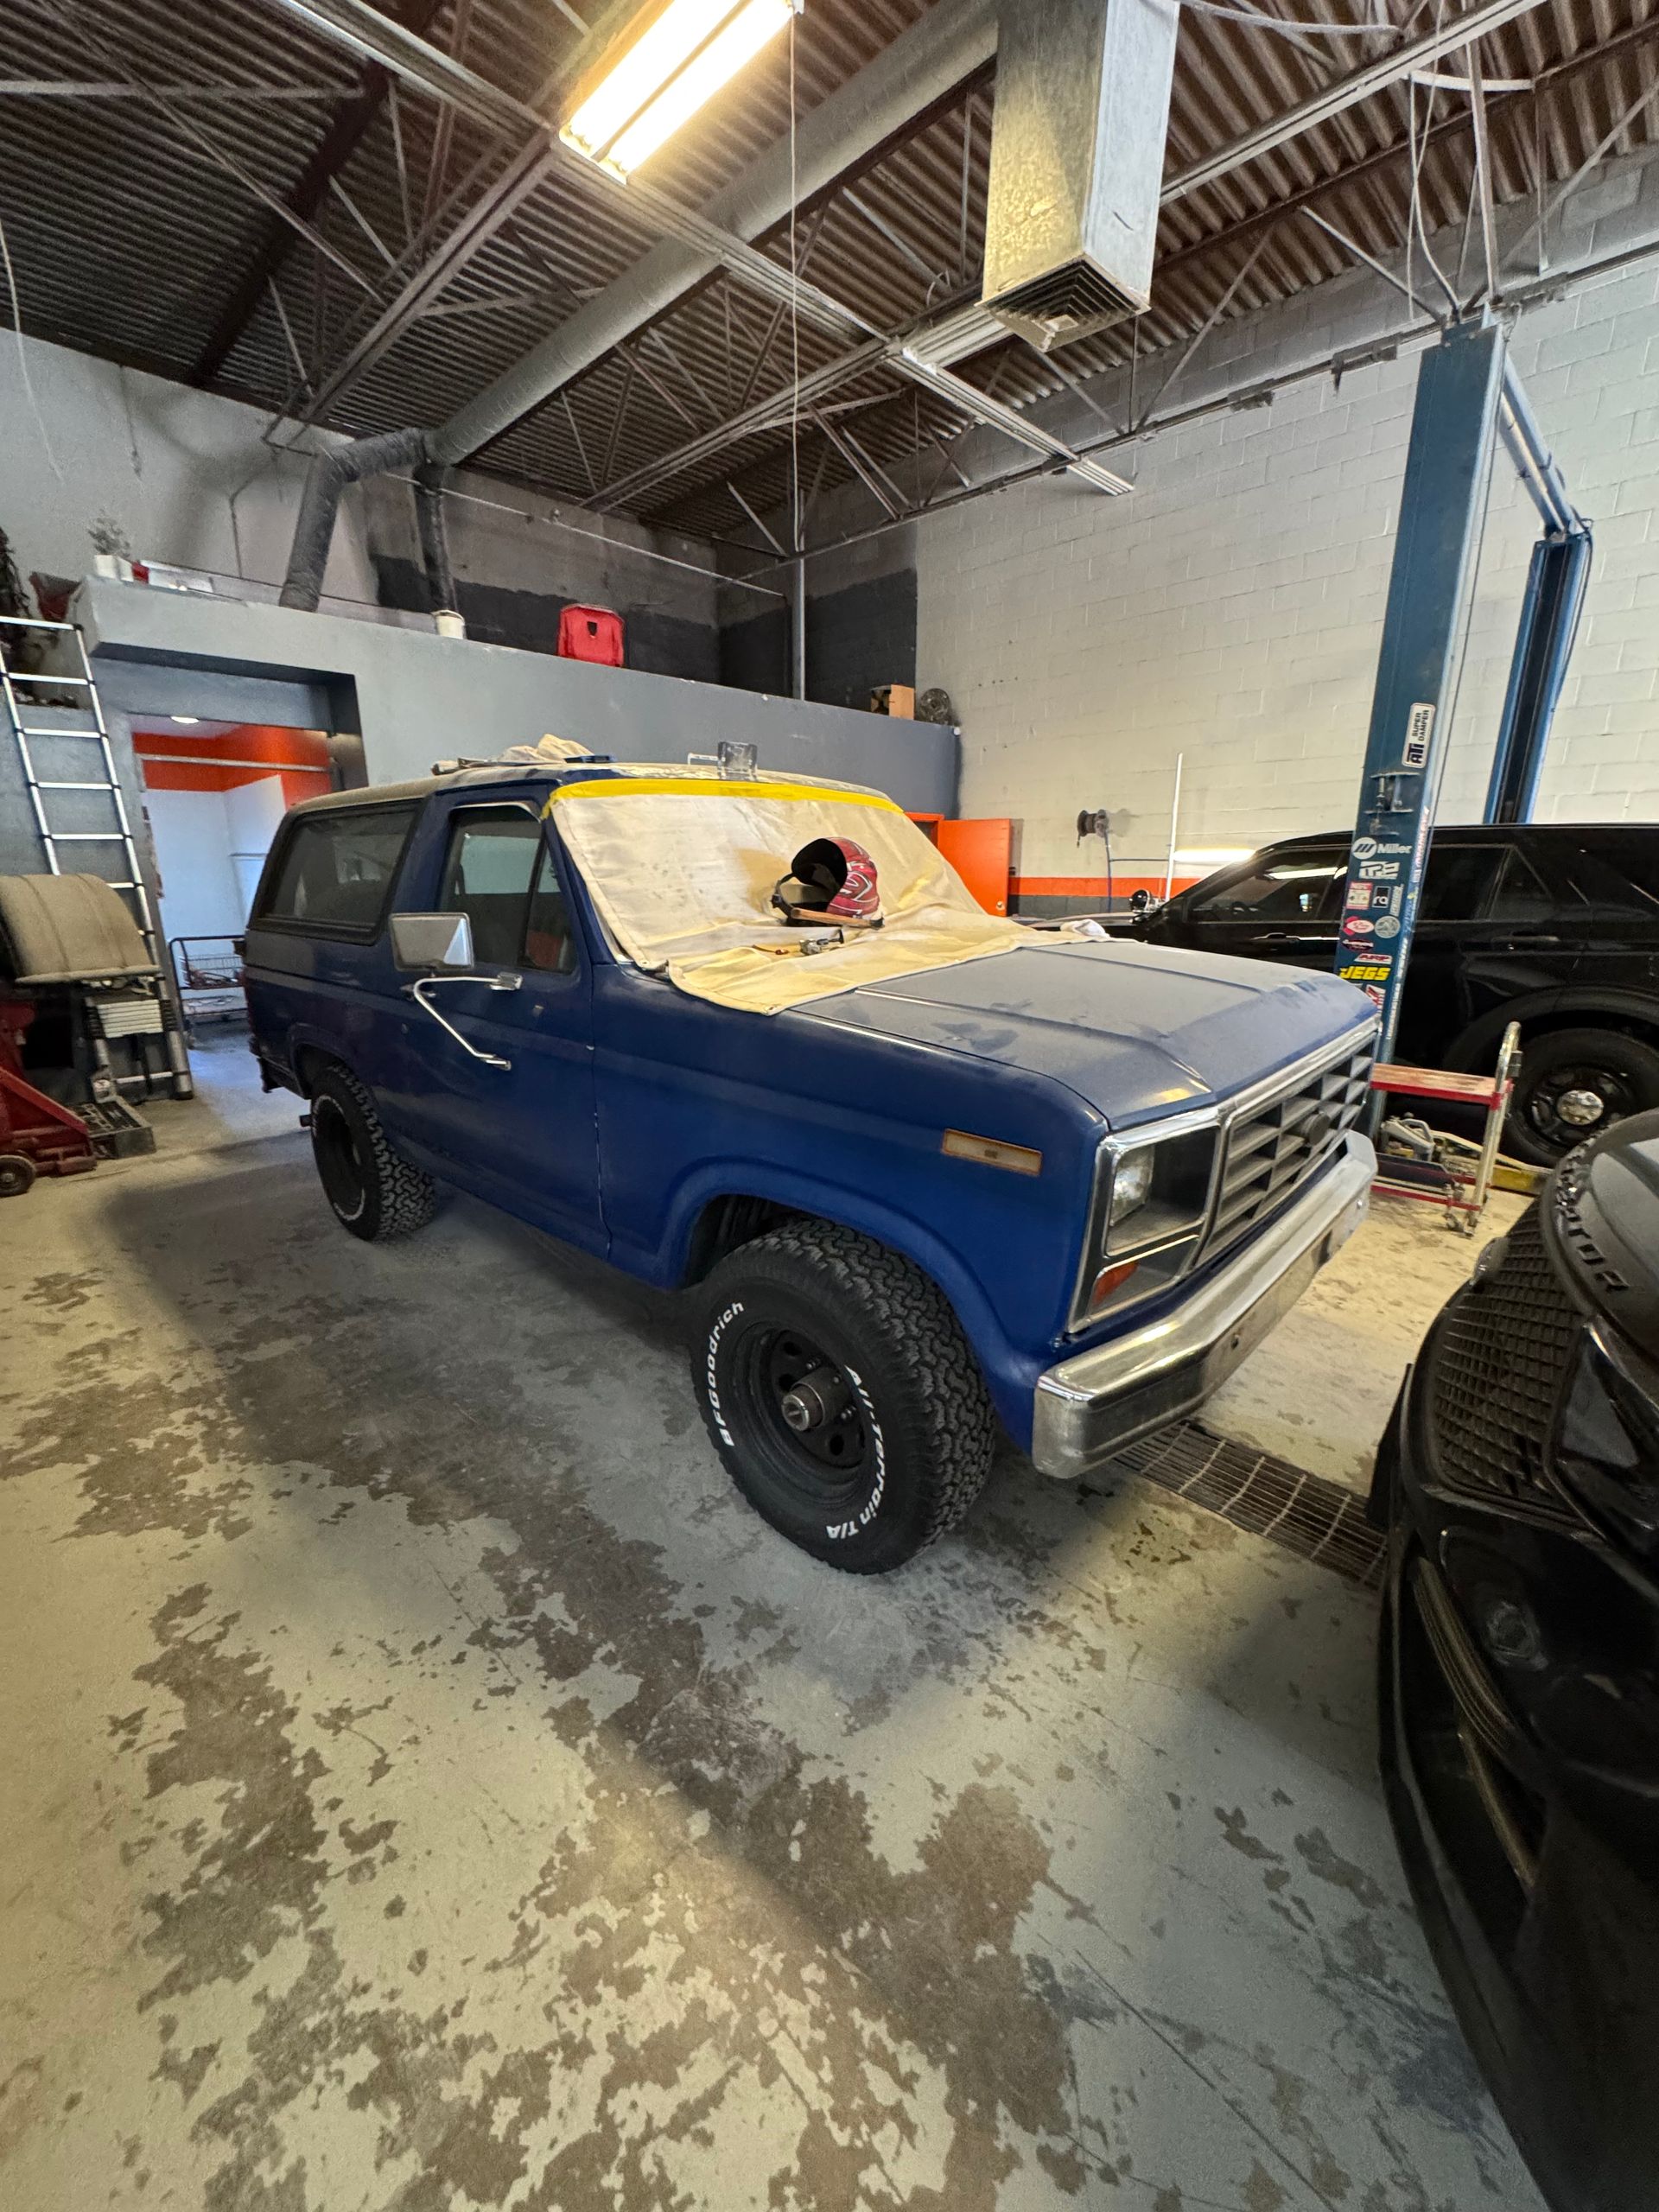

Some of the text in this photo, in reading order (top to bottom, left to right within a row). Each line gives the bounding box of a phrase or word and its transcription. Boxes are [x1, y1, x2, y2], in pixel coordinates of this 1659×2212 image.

[1412, 712, 1421, 737] SUPER
[1417, 709, 1430, 741] DAMPER
[1376, 842, 1413, 855] Miller
[1339, 965, 1391, 981] JEGS
[707, 1302, 745, 1446] BFGoodrich
[825, 1364, 886, 1539] All-Terrain T/A
